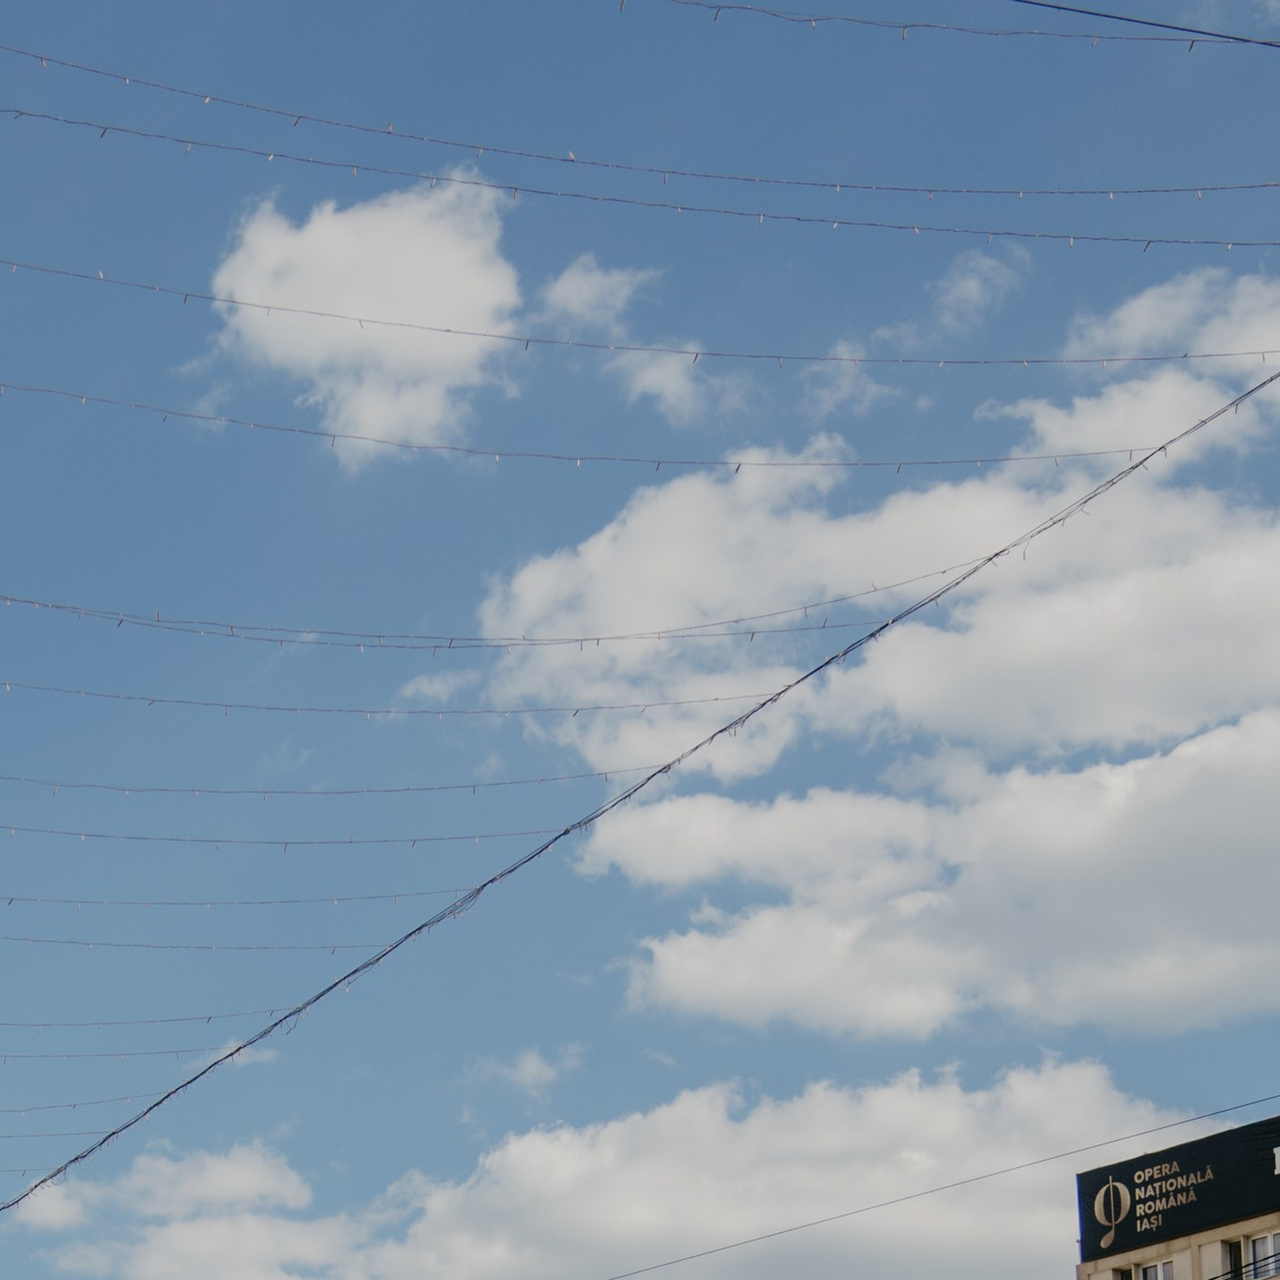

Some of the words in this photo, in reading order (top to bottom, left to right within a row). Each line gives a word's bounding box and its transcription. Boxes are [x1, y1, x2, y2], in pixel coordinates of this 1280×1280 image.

[1133, 1160, 1180, 1184] OPERA
[1135, 1164, 1214, 1201] NAȚIONALĂ
[1136, 1188, 1197, 1217] ROMÂNĂ
[1136, 1214, 1163, 1233] IAȘI
